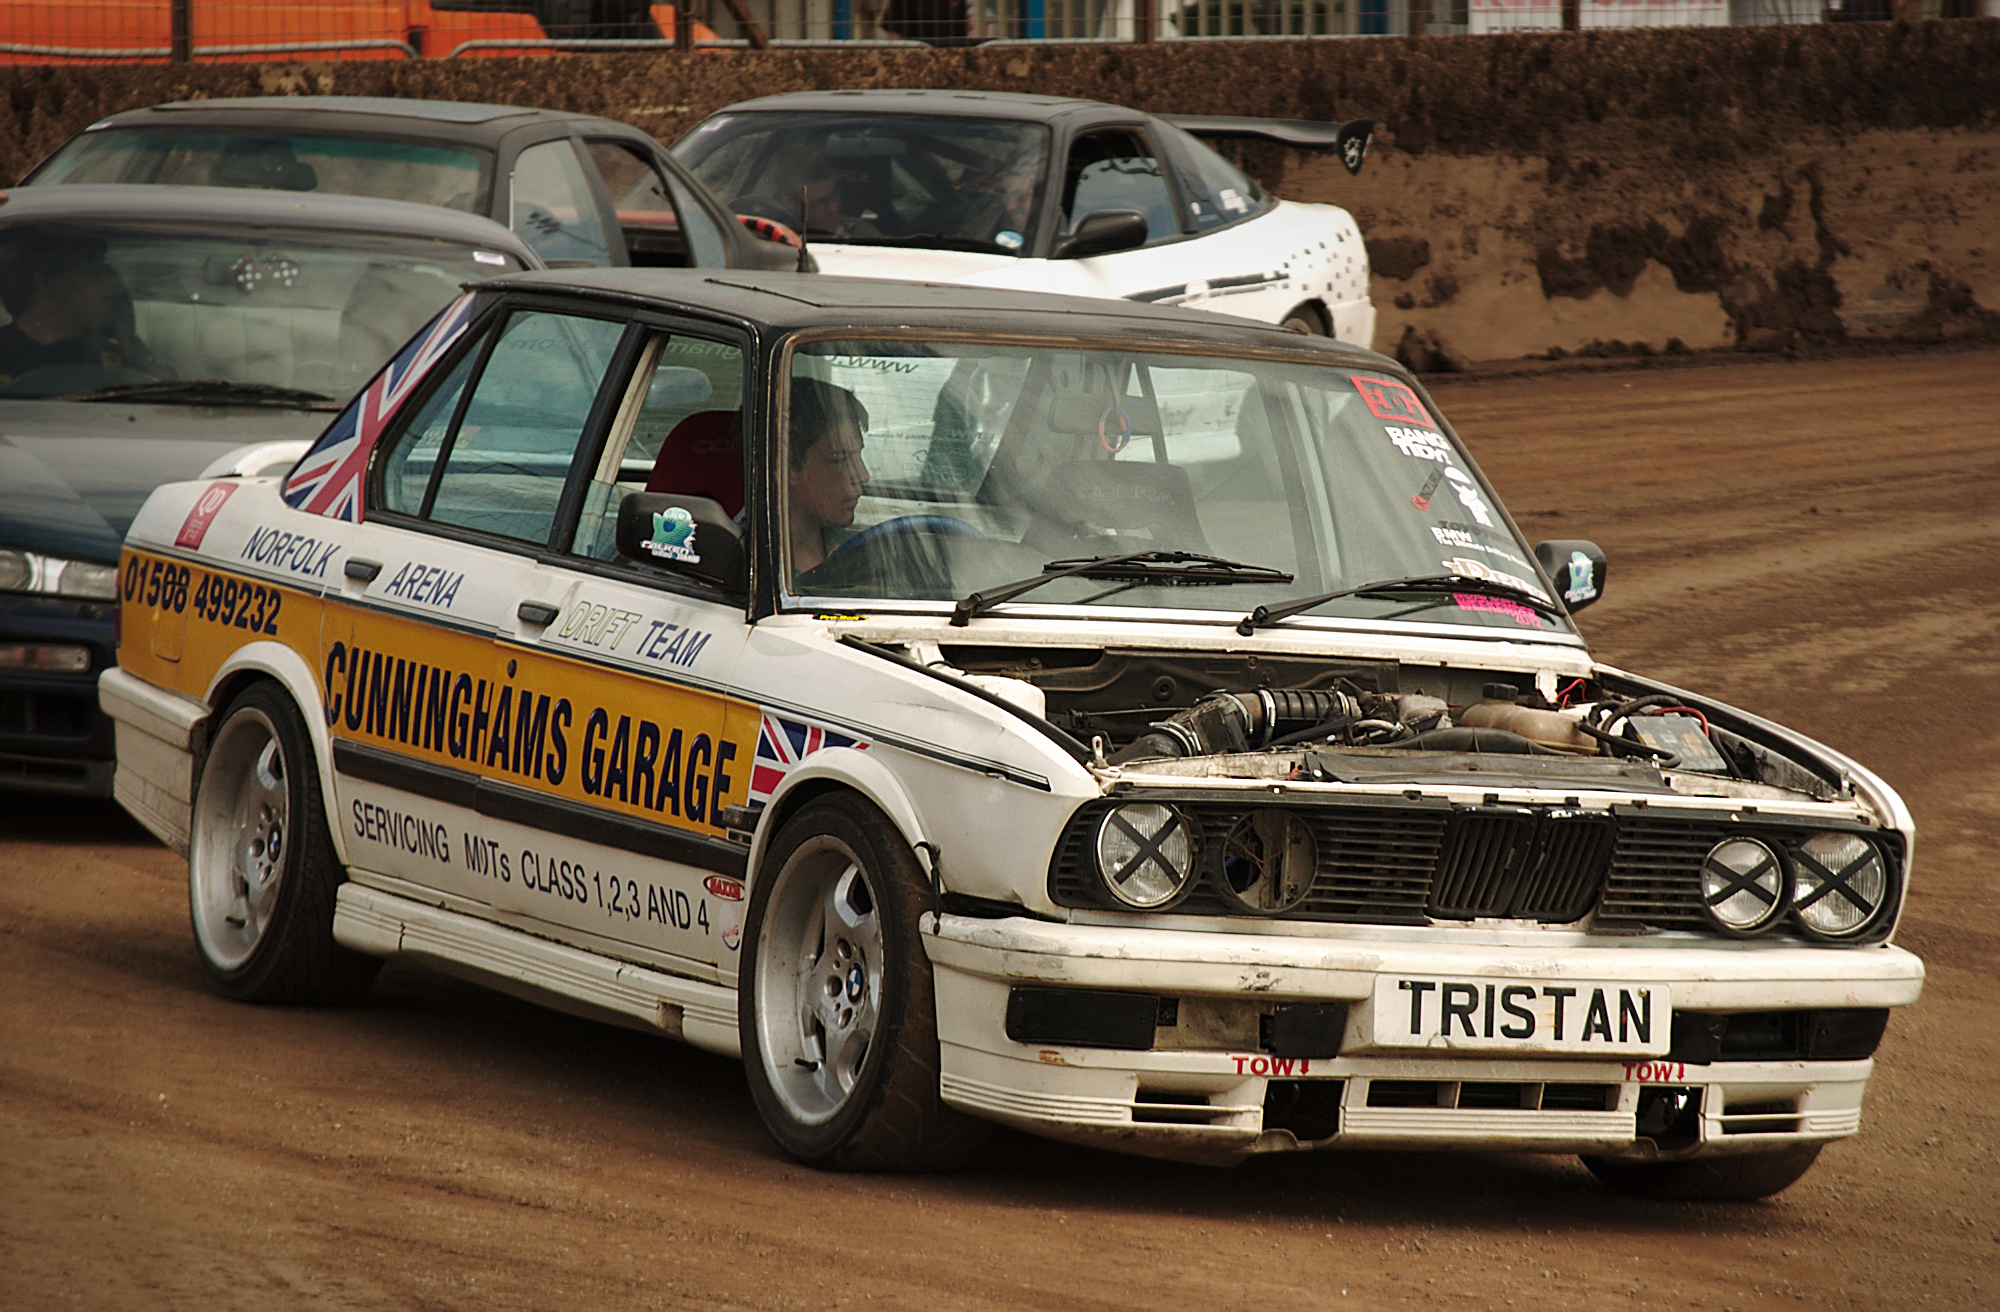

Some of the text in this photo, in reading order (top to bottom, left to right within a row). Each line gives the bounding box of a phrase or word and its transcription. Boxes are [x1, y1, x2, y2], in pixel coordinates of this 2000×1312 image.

[1385, 426, 1451, 450] BANG
[1431, 526, 1472, 543] BMW
[124, 556, 281, 636] 01508 499232
[241, 526, 341, 578] NORFOLK
[384, 562, 465, 608] ARENA
[559, 601, 643, 650] DRIFT
[637, 620, 712, 668] TEAM
[325, 641, 737, 828] CUNNINGHAMS GARAGE
[352, 799, 450, 863] SERVICING
[521, 850, 587, 904] CLASS
[594, 871, 641, 922] 1,2,3
[648, 885, 691, 930] AND
[698, 899, 710, 936] 4
[1398, 980, 1652, 1043] TRISTAN
